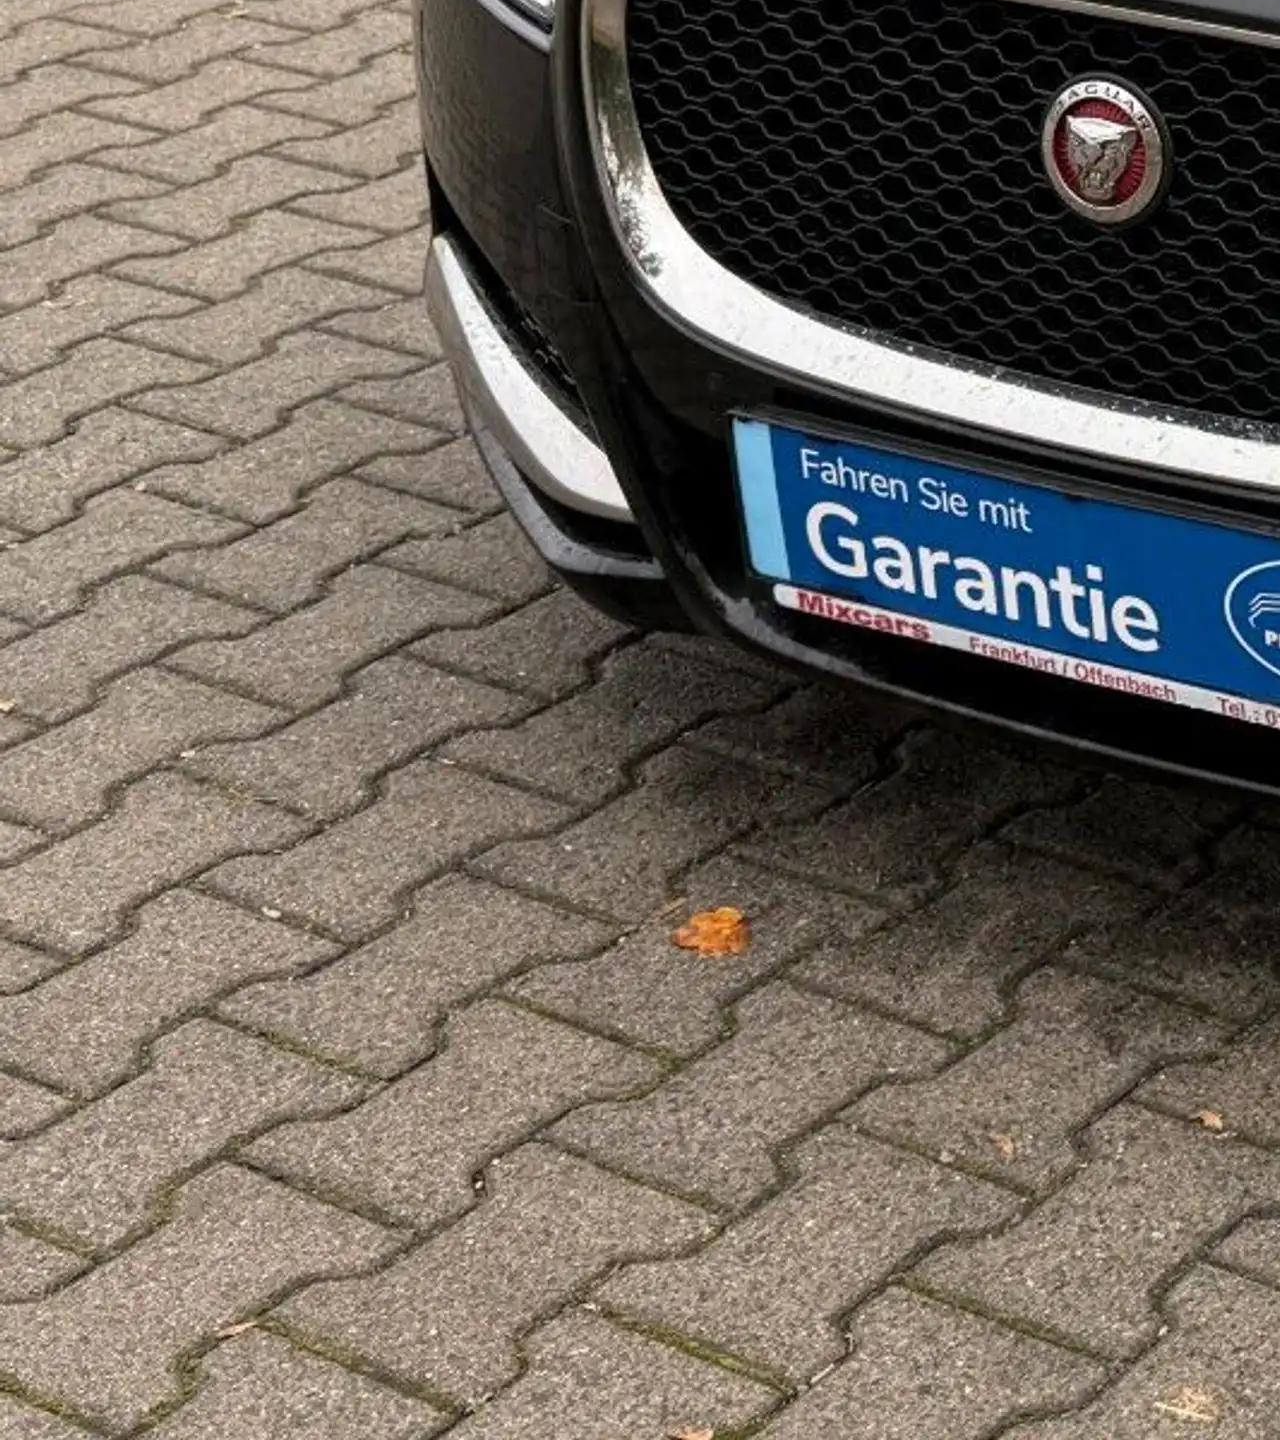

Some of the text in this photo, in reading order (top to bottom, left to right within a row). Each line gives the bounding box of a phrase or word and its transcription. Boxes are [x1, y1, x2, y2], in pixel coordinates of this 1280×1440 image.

[800, 448, 1033, 533] Fahren Sie mit
[796, 590, 932, 642] Mixcars
[805, 501, 1160, 653] Garantie
